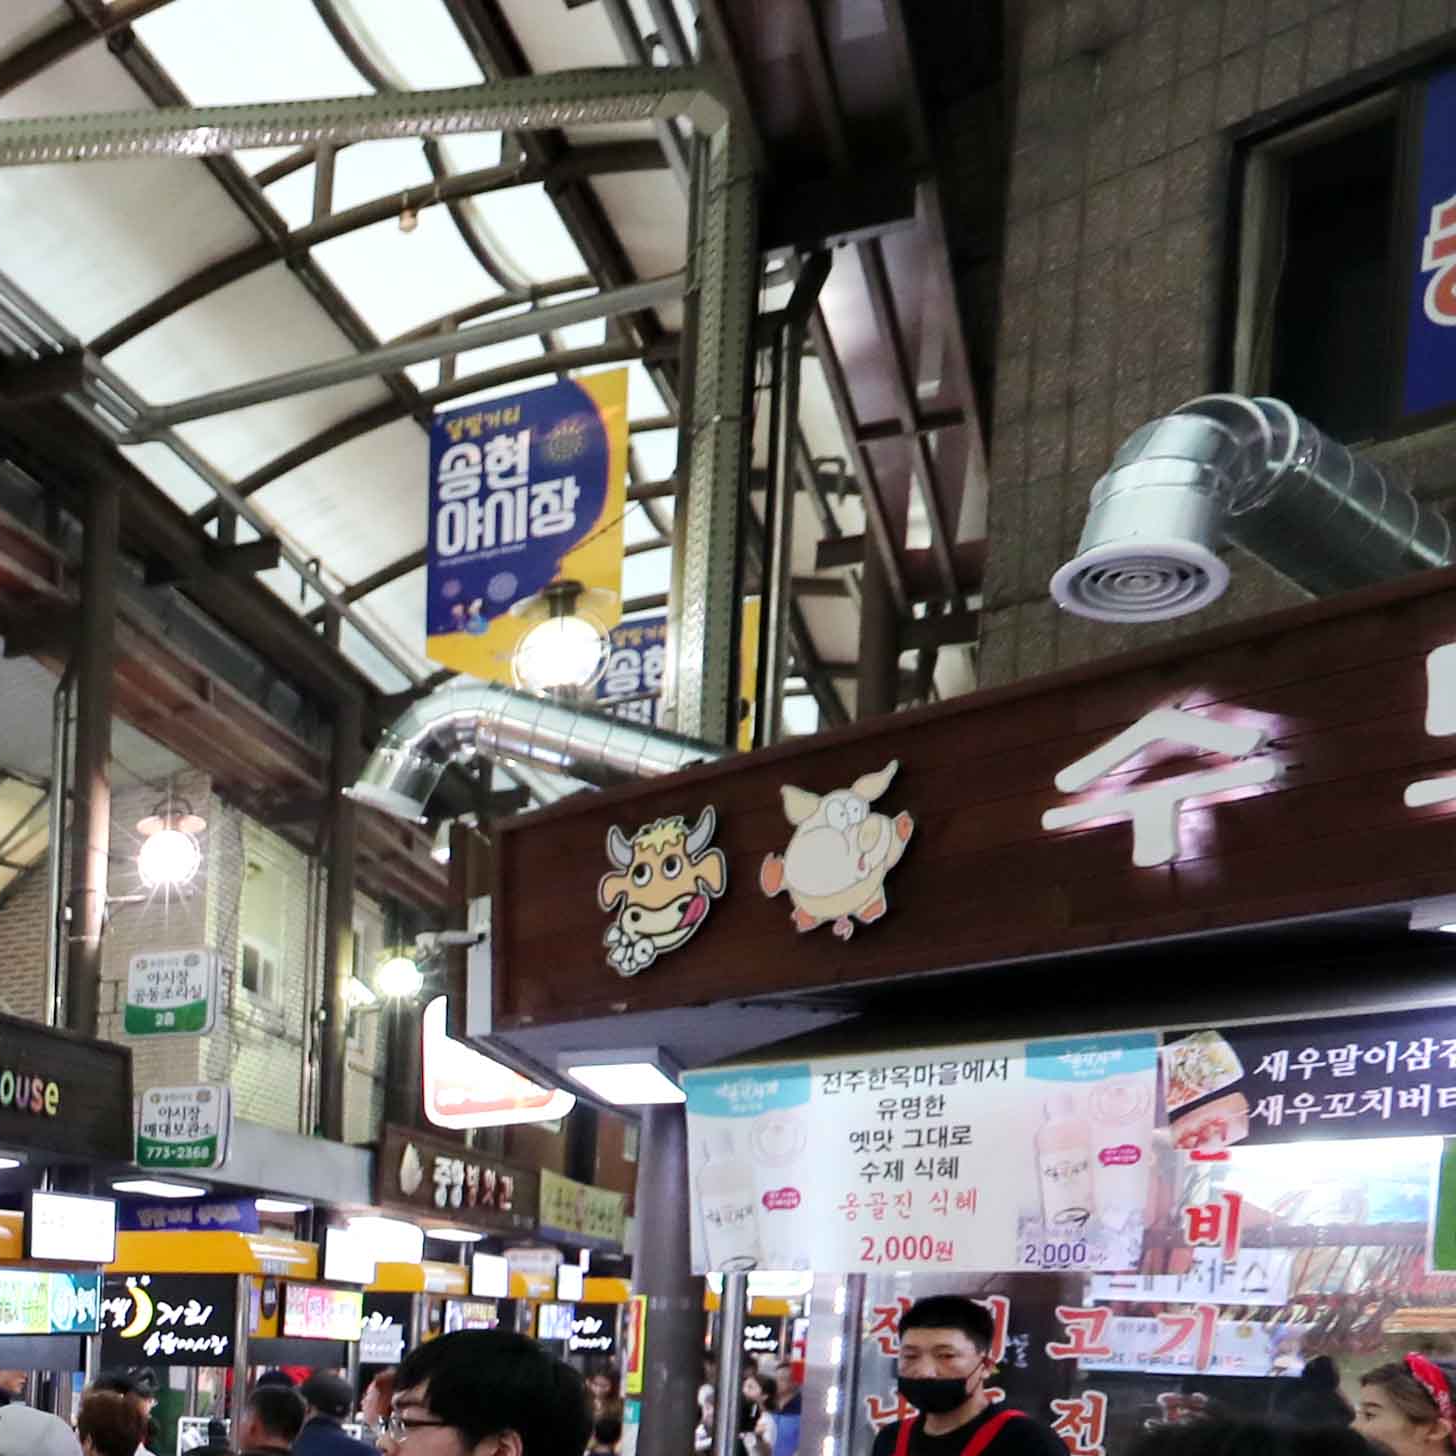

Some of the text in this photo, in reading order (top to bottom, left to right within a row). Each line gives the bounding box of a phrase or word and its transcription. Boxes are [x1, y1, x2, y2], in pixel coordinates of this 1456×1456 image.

[439, 429, 531, 502] 송현
[437, 475, 580, 557] 야시장
[878, 1094, 947, 1121] 유명한
[849, 1125, 973, 1153] 옛맛 그대로
[860, 1156, 960, 1183] 수제 식혜
[929, 1188, 979, 1218] 식혜
[860, 1234, 955, 1265] 2,000원
